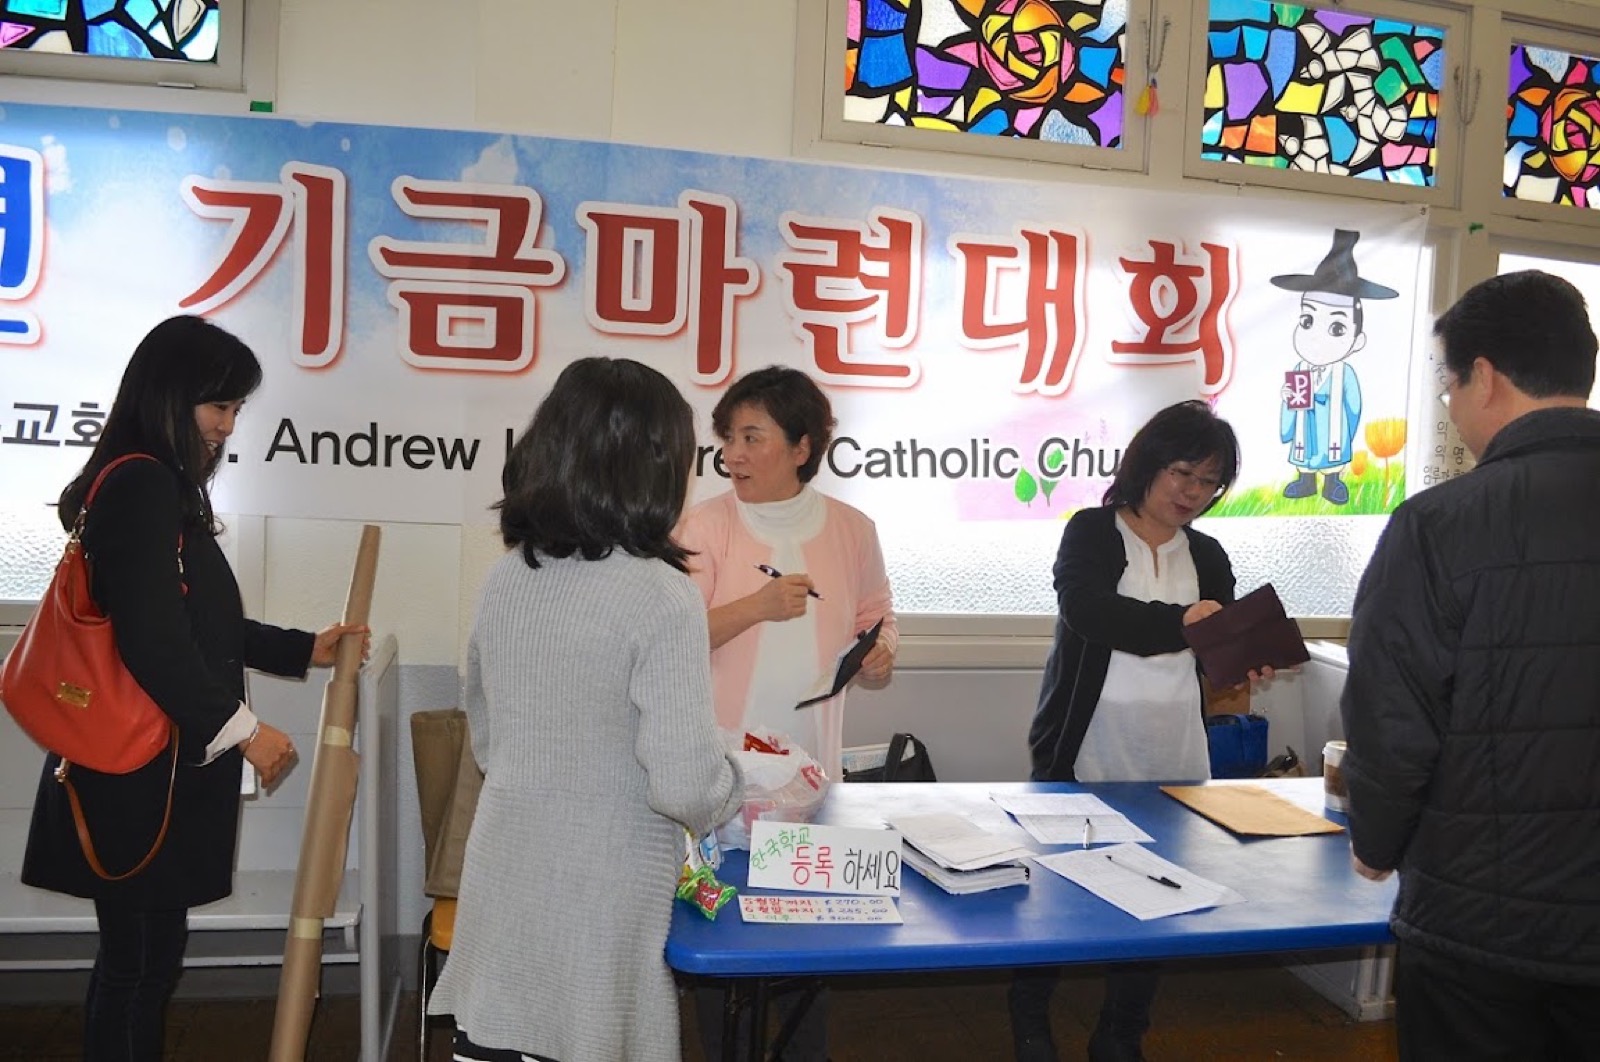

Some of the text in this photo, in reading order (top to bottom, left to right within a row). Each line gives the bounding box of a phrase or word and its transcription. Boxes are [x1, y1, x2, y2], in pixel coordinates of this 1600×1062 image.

[265, 417, 480, 470] Andrew
[828, 434, 1019, 478] Catholic
[1038, 437, 1120, 478] Chu
[751, 826, 814, 870] 한국학교
[790, 846, 899, 892] 등록 하세요
